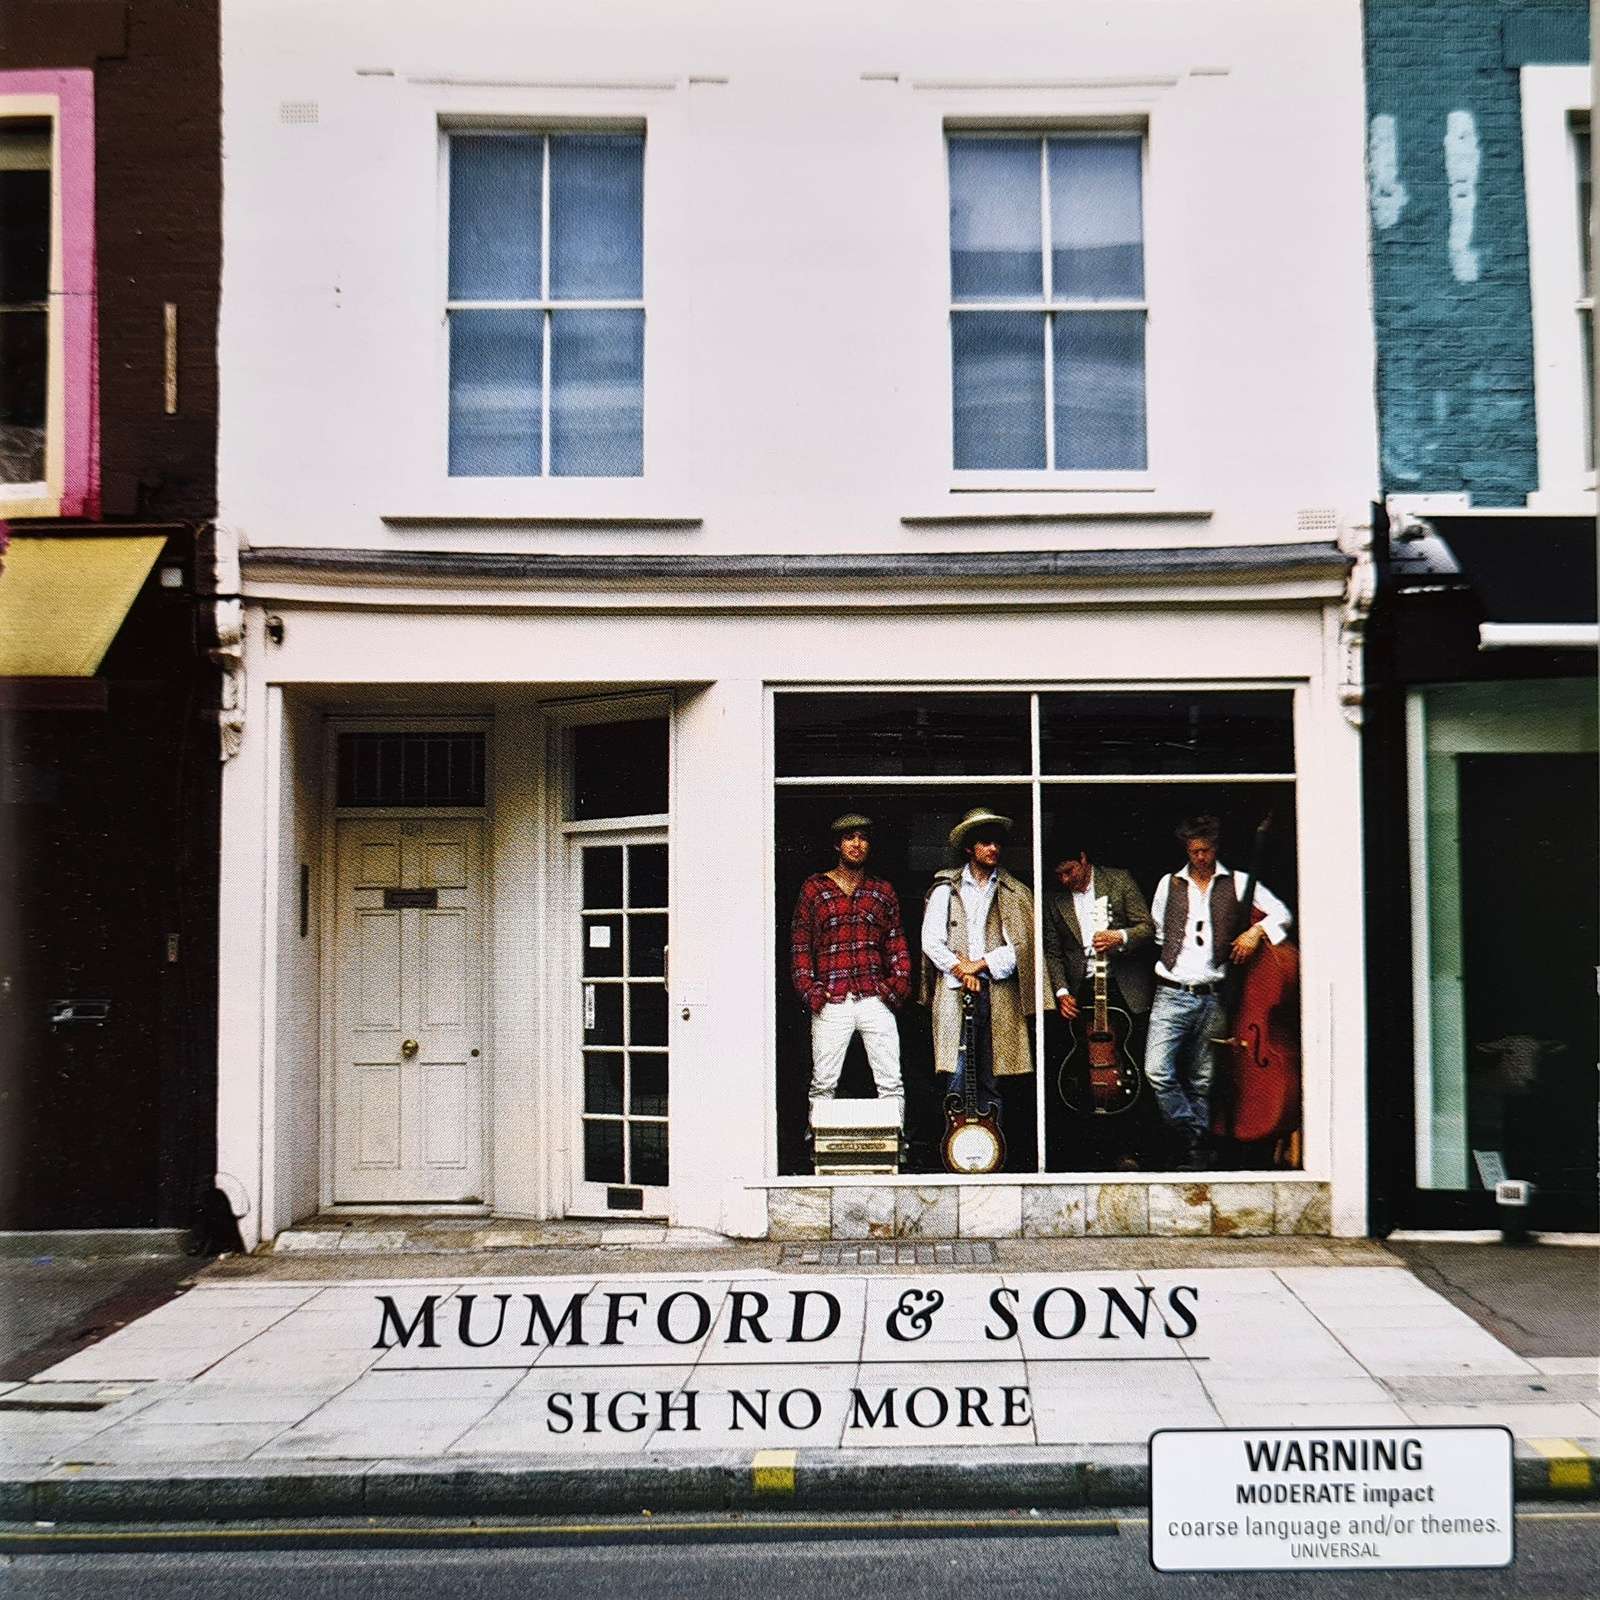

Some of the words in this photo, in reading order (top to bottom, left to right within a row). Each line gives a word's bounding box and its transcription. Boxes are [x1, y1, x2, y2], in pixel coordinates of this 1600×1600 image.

[371, 1290, 841, 1349] MUMFORD
[886, 1288, 944, 1342] &
[984, 1285, 1199, 1341] SONS
[546, 1390, 701, 1434] SIGH
[727, 1388, 822, 1430] NO
[849, 1386, 1033, 1429] MORE
[1244, 1438, 1424, 1473] WARNING
[1235, 1483, 1355, 1505] MODERATE
[1362, 1482, 1435, 1507] impact
[1167, 1518, 1238, 1536] coarse
[1245, 1514, 1341, 1541] language
[1348, 1513, 1415, 1537] and/or
[1421, 1513, 1502, 1535] themes.
[1290, 1542, 1380, 1559] UNIVERSAL
